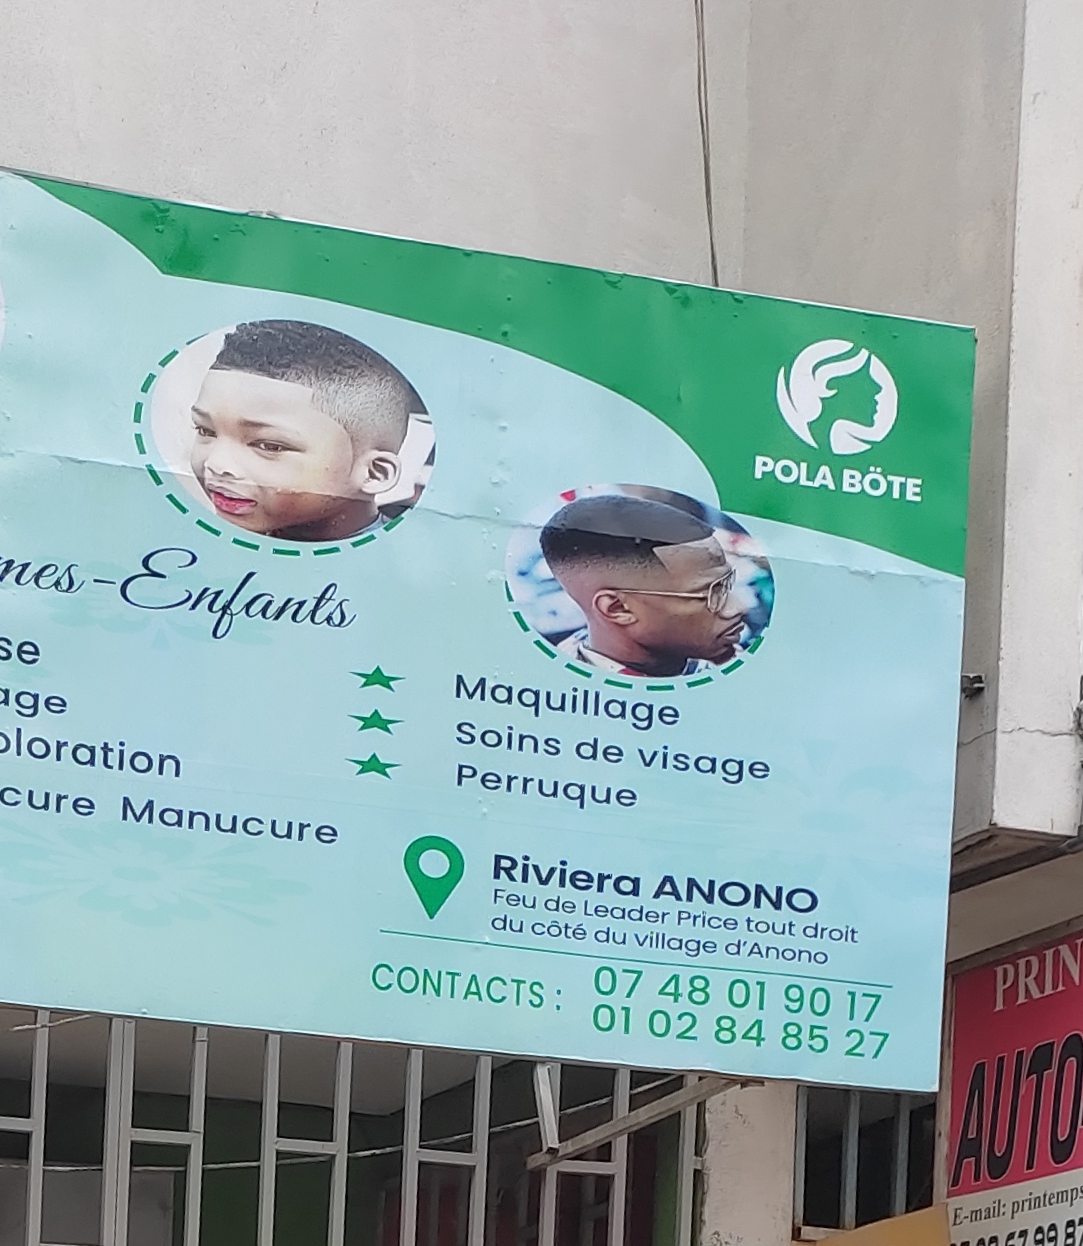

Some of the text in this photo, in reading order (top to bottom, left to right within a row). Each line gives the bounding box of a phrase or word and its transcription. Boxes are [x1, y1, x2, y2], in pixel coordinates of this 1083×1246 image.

[754, 455, 923, 502] POLA BÖTE
[455, 673, 680, 731] Maquillage
[455, 720, 771, 785] Soins de visage
[456, 763, 638, 809] Perruque
[121, 796, 339, 844] Manucure
[492, 853, 819, 914] Riviera ANONO
[491, 913, 829, 965] du côté du village d'Anono
[493, 888, 860, 945] Feu de Leader Price tout droit
[371, 963, 545, 1009] CONTACTS
[594, 965, 883, 1023] 07 48 01 90 17
[993, 938, 1083, 1013] PRIN
[592, 1003, 890, 1060] 01 02 84 85 27
[952, 1199, 1006, 1226] E-mail:
